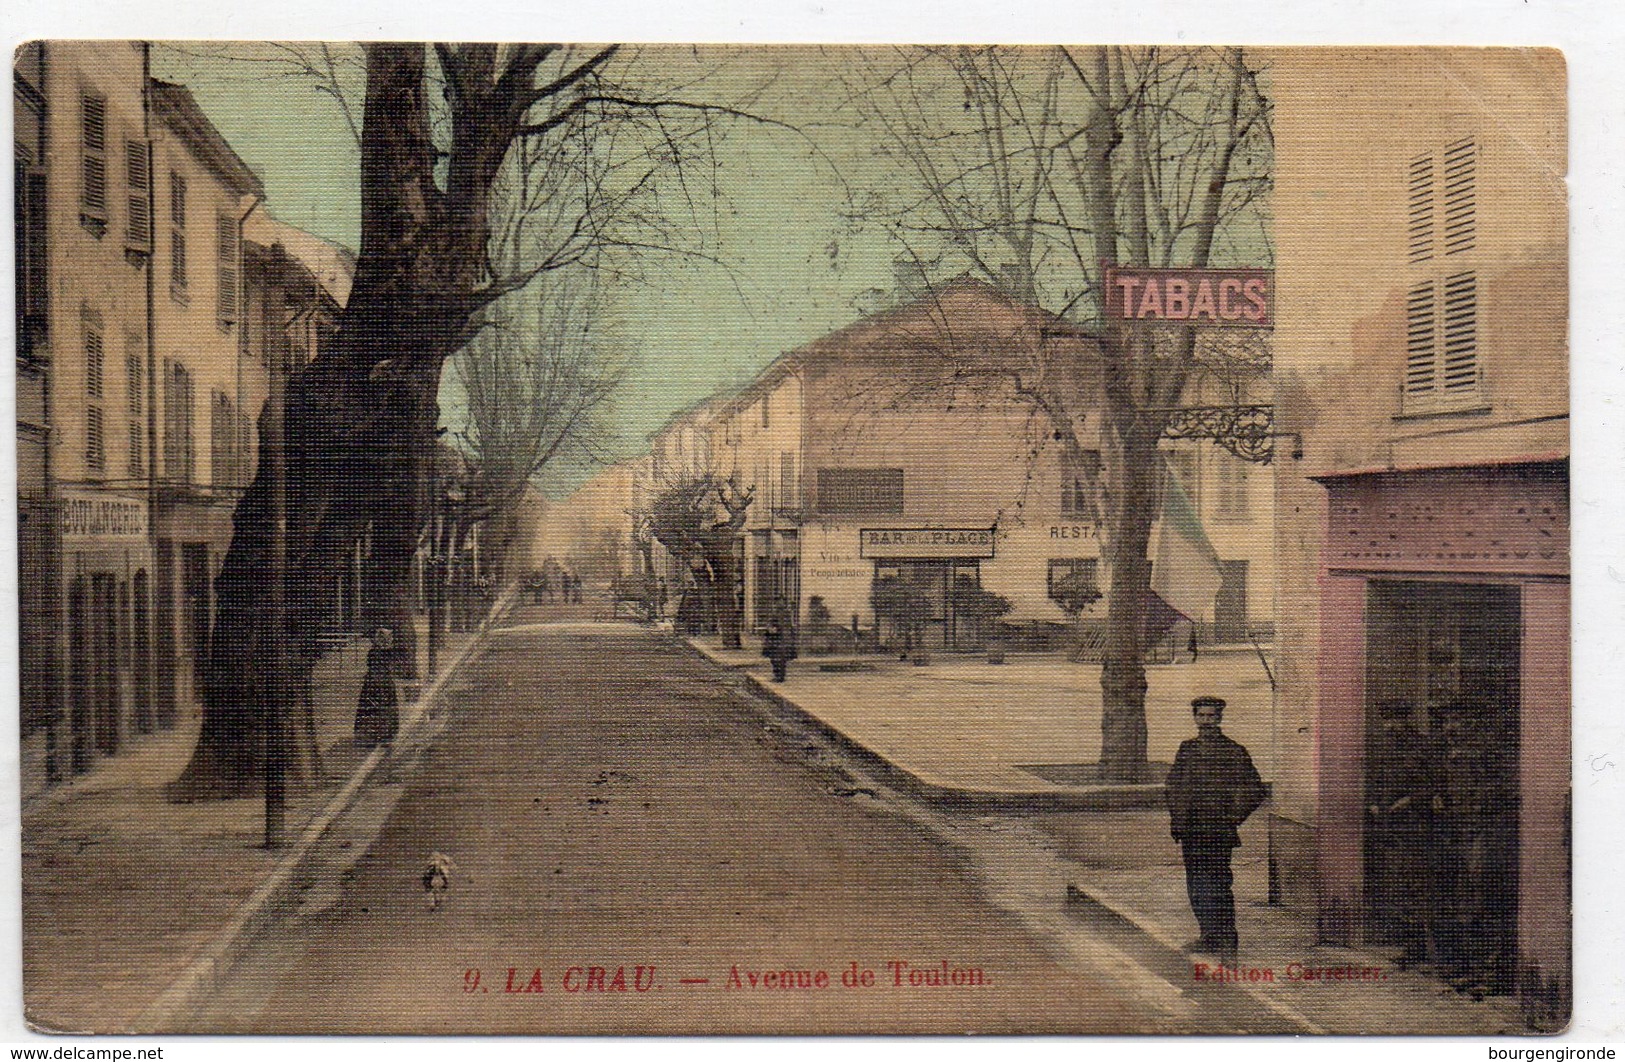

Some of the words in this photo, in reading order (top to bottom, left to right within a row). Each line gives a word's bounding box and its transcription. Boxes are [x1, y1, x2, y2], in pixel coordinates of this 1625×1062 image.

[1116, 278, 1267, 320] TABACS
[60, 499, 143, 535] BOULANGERIE
[869, 532, 904, 545] BAR
[931, 532, 989, 545] PLACE
